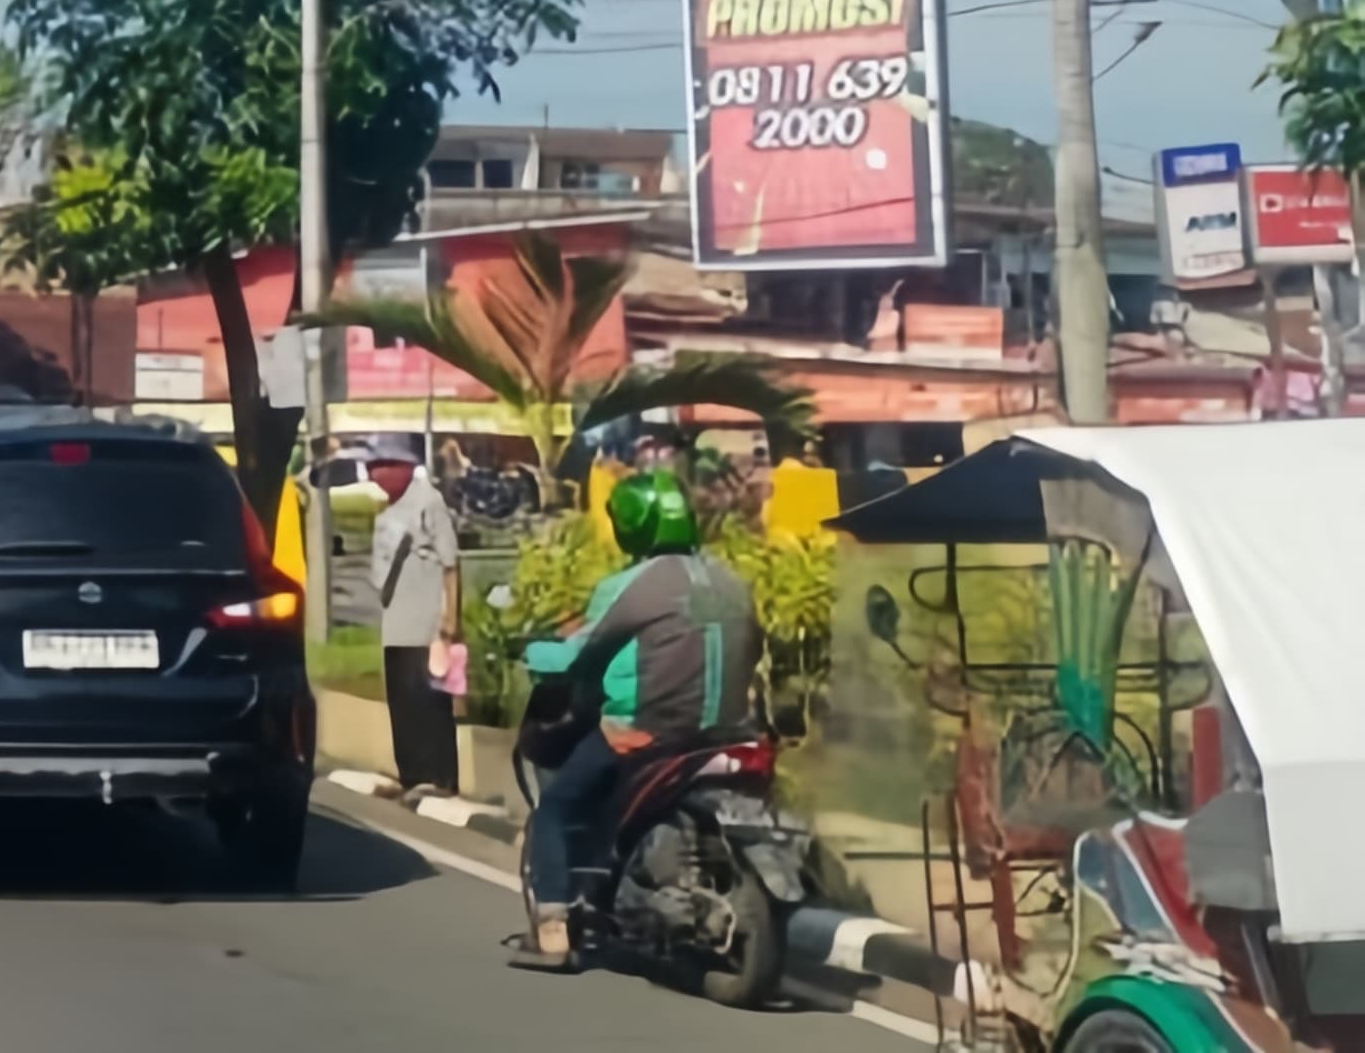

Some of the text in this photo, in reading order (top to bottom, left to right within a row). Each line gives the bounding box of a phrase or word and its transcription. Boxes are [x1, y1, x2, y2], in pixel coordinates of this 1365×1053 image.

[708, 56, 908, 106] 0811 639
[753, 106, 866, 149] 2000
